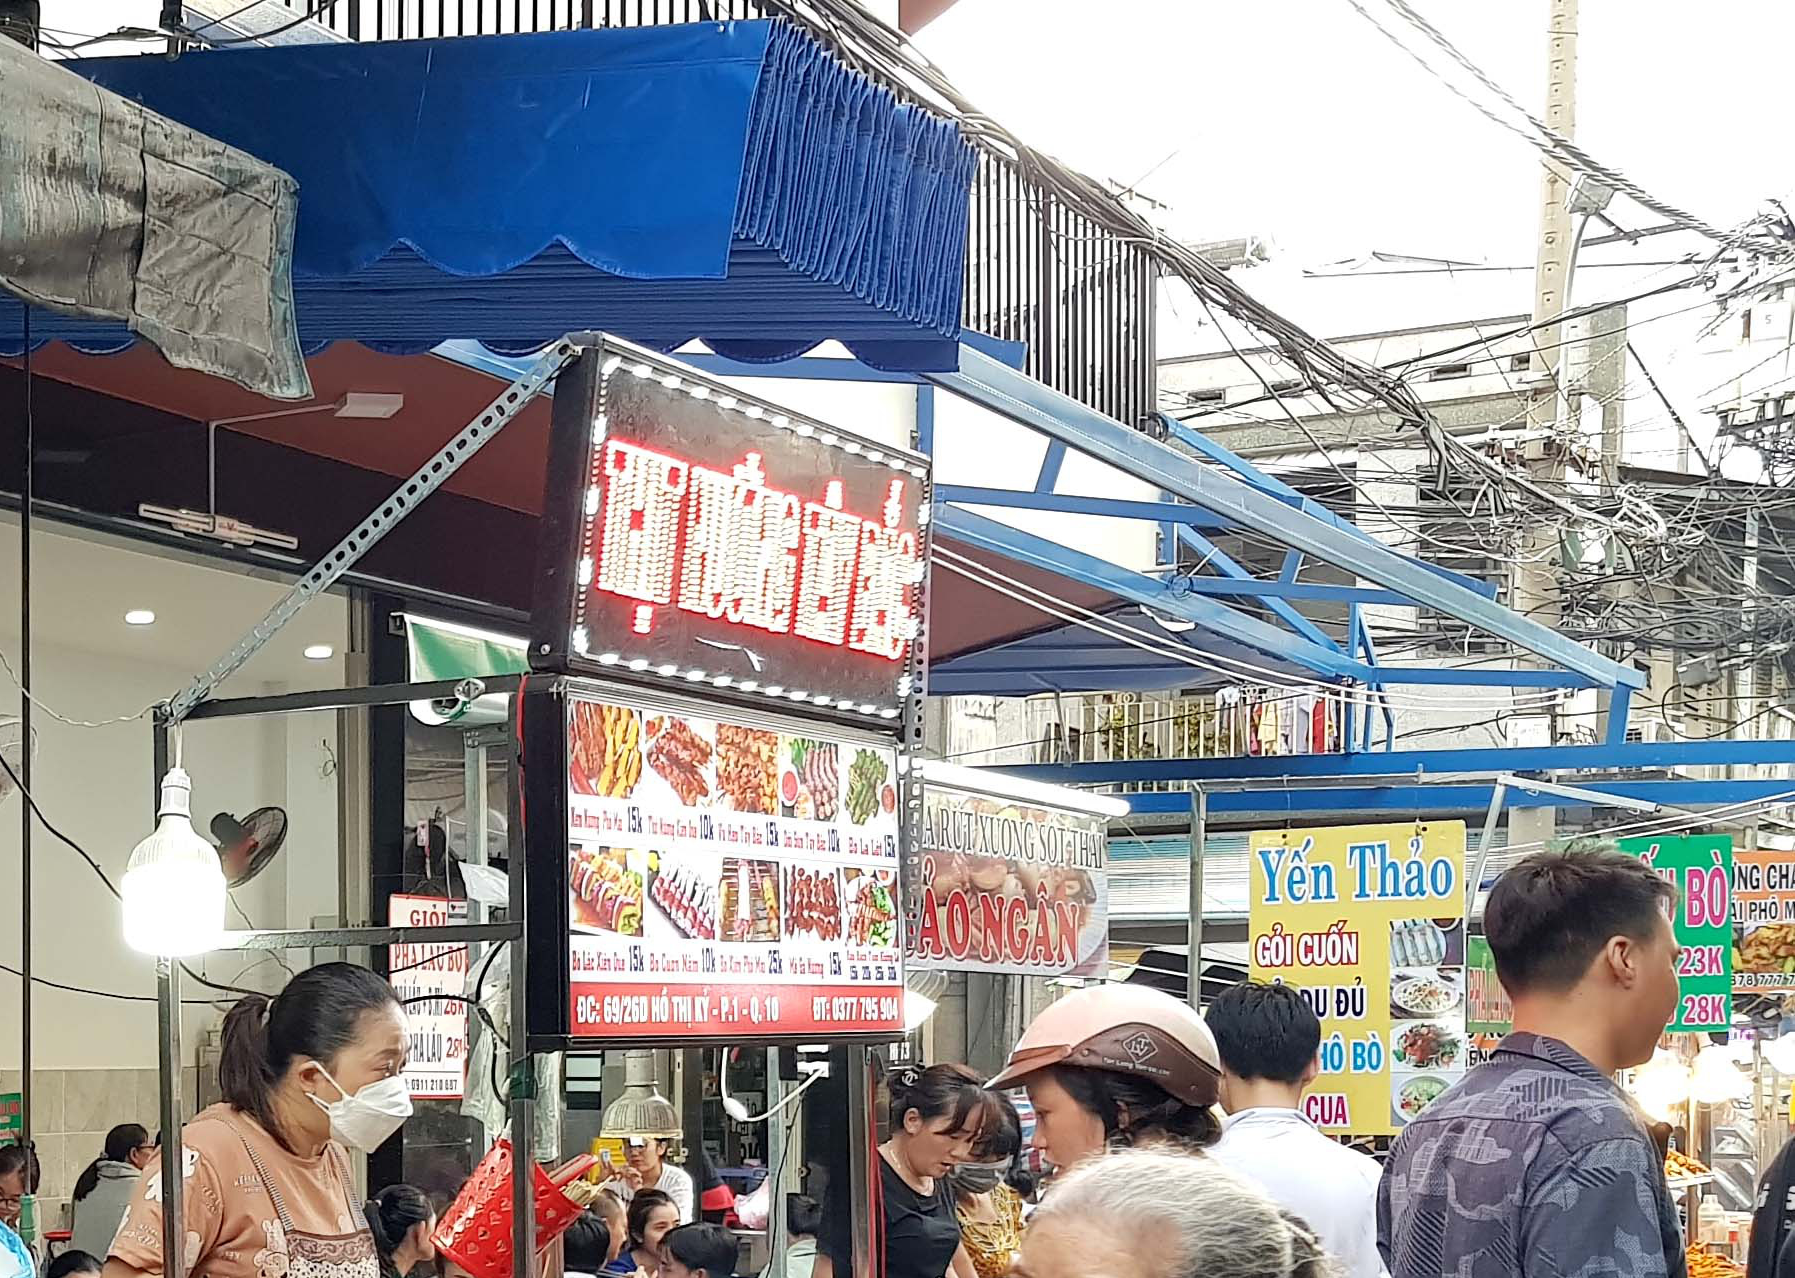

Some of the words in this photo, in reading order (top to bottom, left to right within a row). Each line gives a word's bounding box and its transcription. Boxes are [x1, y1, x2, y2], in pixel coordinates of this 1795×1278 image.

[1258, 838, 1338, 903] Yến
[1348, 838, 1454, 900] Thảo
[1686, 850, 1728, 927] BÒ
[979, 881, 1080, 966] NGÂN
[1255, 922, 1293, 967] GỎI
[1297, 919, 1359, 966] CUỐN
[1678, 946, 1723, 975] 23K
[576, 995, 601, 1024] ĐC:
[603, 994, 648, 1025] 69/26D
[1335, 975, 1364, 1017] ĐỦ
[1683, 995, 1726, 1024] 28K
[1352, 1032, 1382, 1071] BÒ
[1306, 1095, 1347, 1125] CUA
